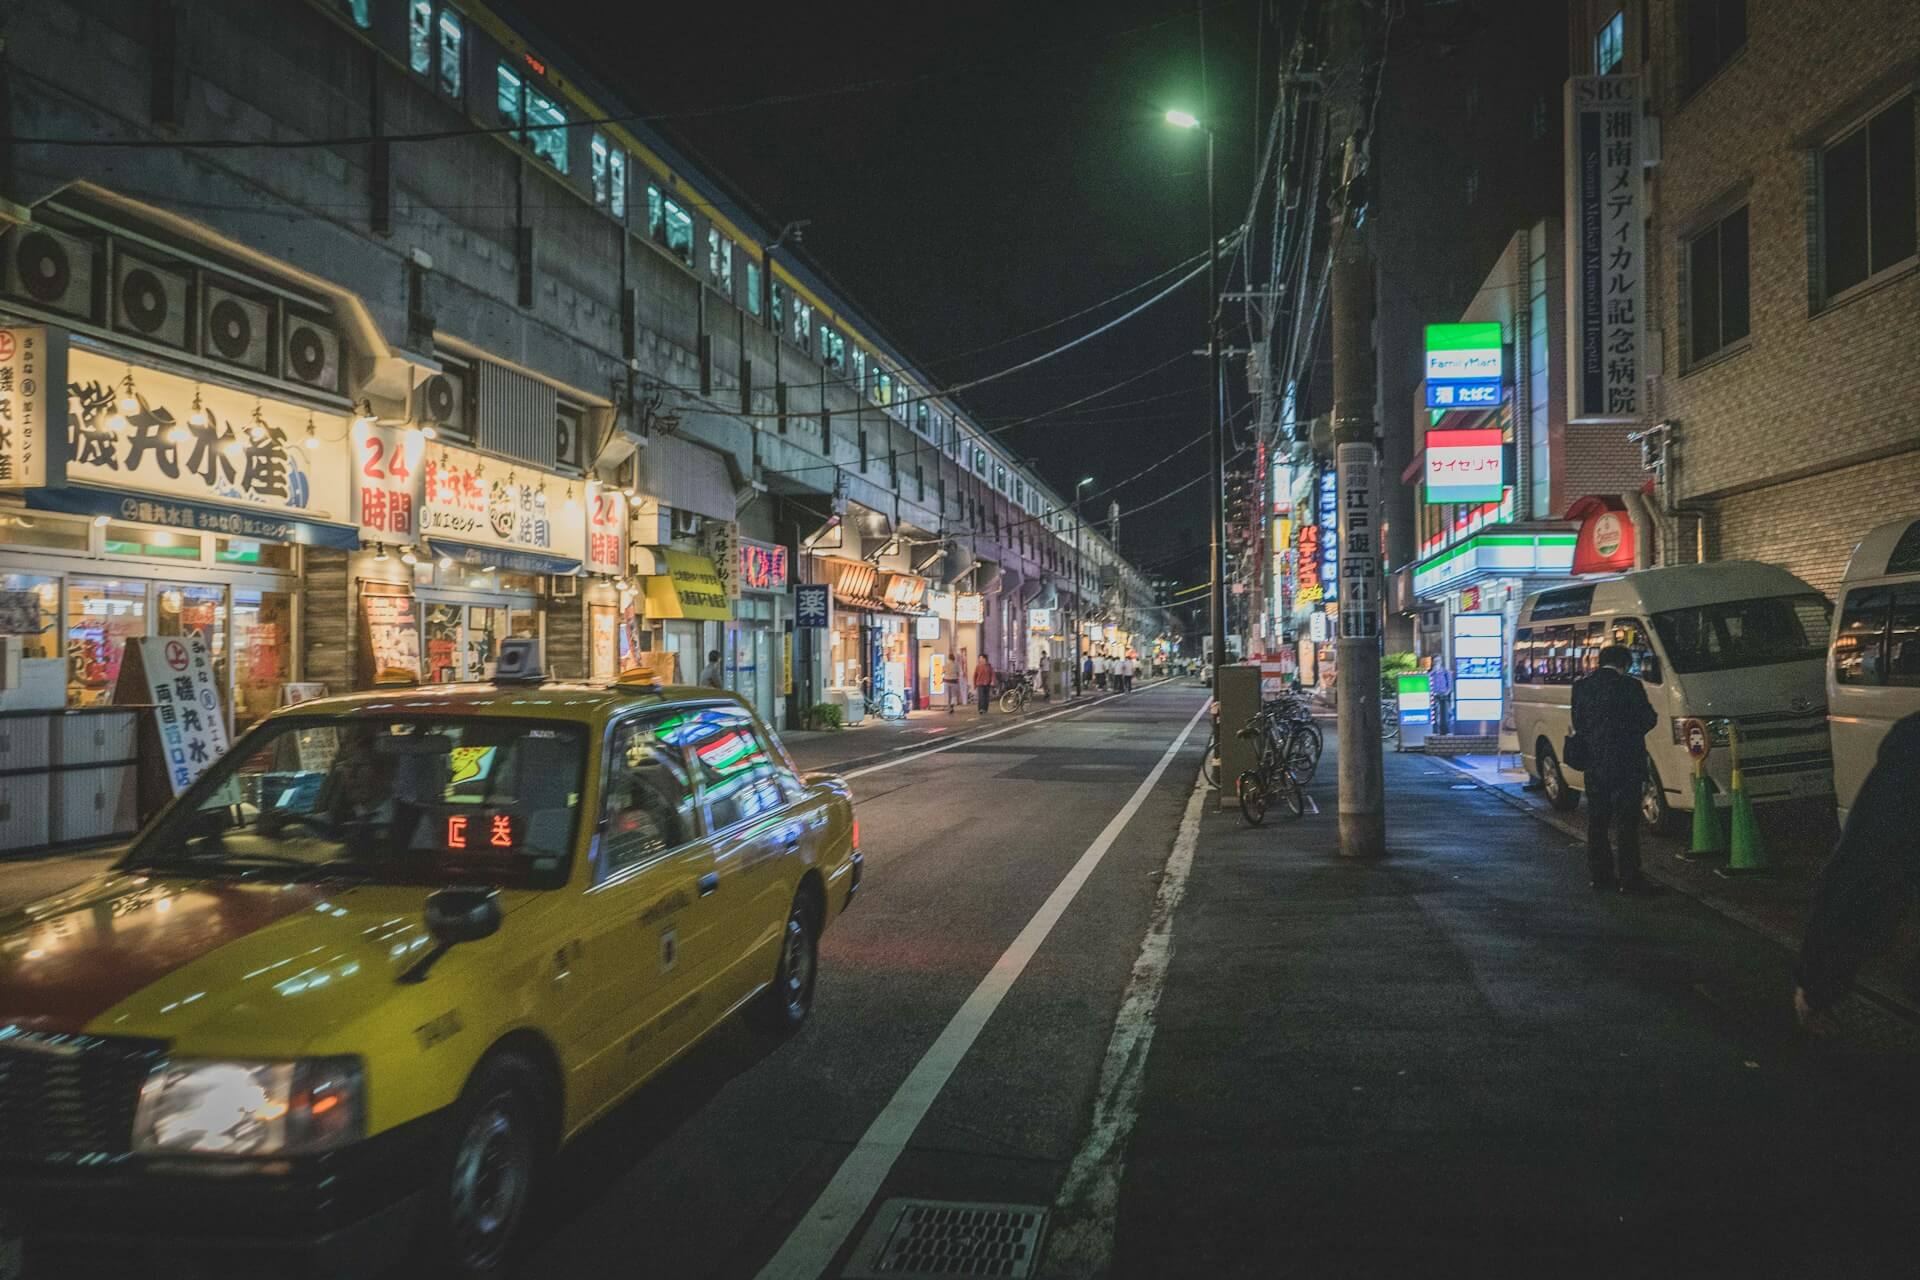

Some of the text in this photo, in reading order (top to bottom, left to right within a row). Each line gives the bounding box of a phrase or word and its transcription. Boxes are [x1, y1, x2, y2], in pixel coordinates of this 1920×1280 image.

[1581, 80, 1633, 101] SBC
[1585, 202, 1599, 253] Medical
[1605, 111, 1635, 415] 湘南メディカル記念病院
[1458, 386, 1496, 402] たばこ
[67, 380, 289, 498] 磯丸水産
[363, 437, 410, 484] 24
[362, 488, 413, 535] 時間
[592, 495, 619, 528] 24
[1348, 489, 1370, 553] 江戸遊
[592, 532, 620, 567] 時間
[1299, 525, 1318, 589] パチンコ
[799, 590, 826, 618] 薬
[173, 674, 210, 780] 磯丸水
